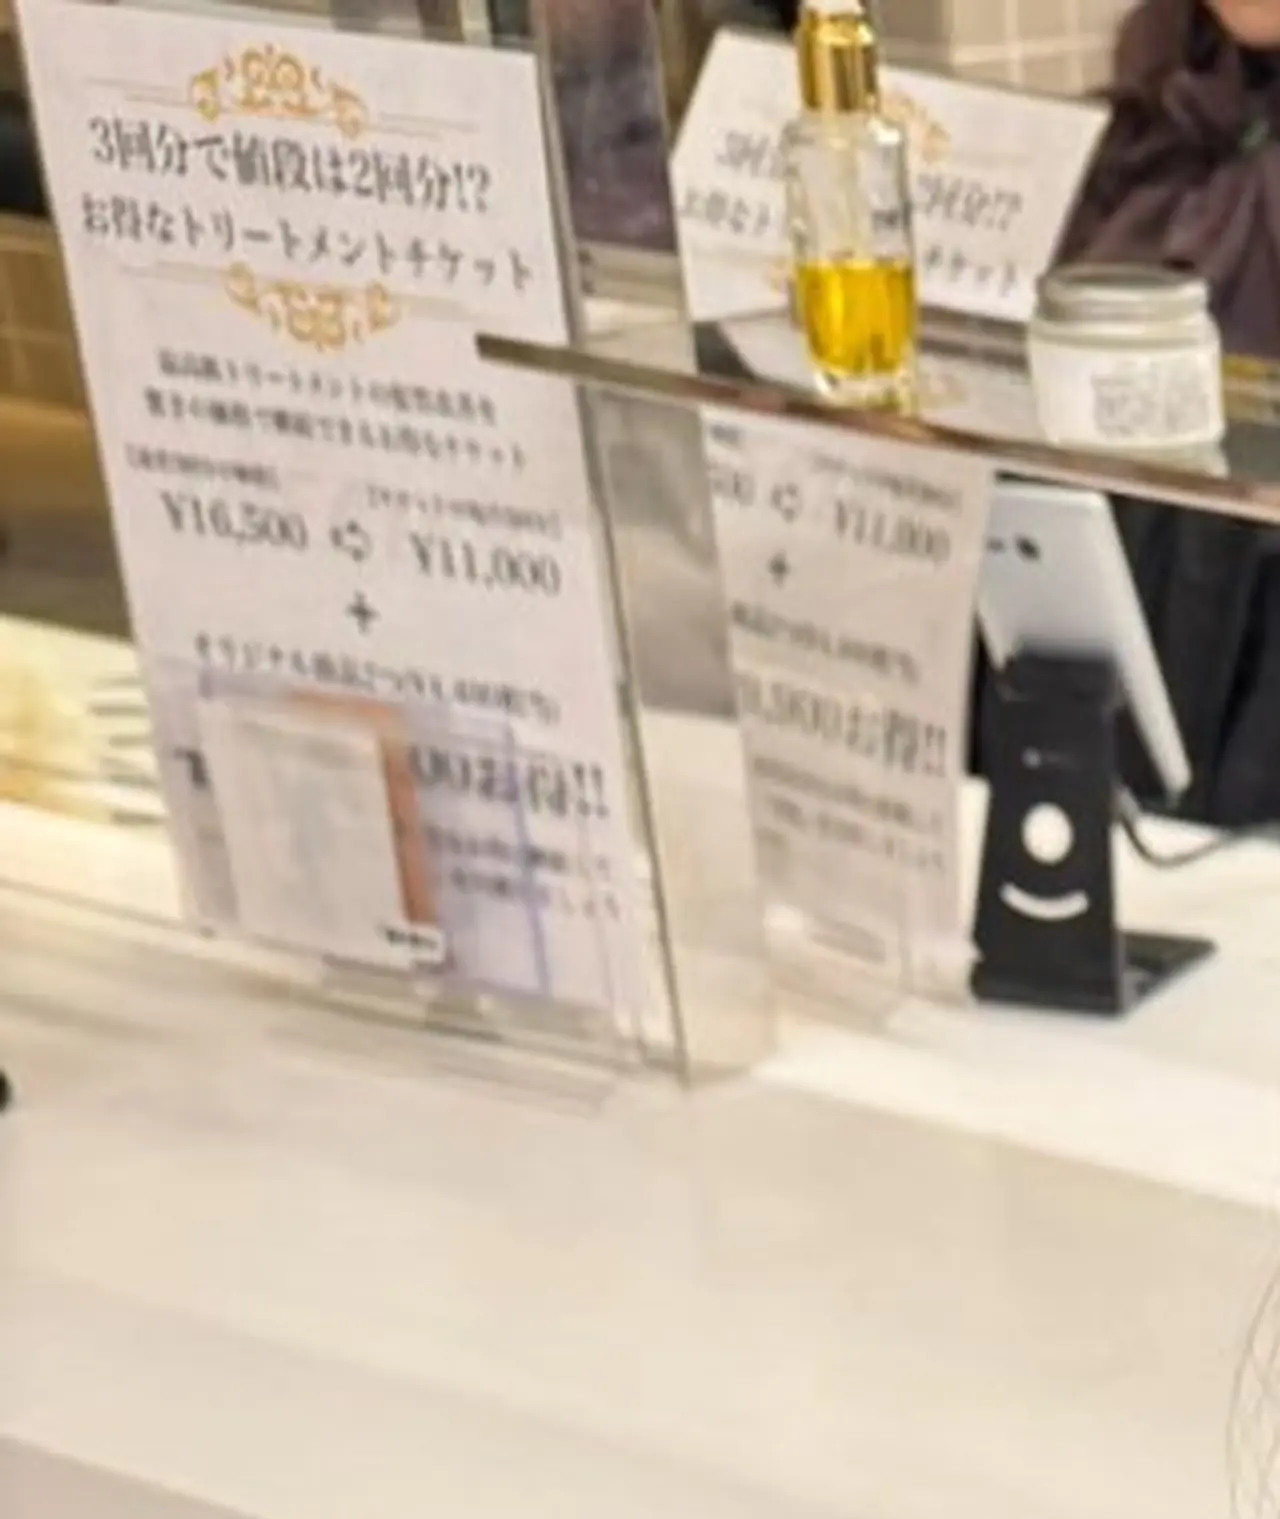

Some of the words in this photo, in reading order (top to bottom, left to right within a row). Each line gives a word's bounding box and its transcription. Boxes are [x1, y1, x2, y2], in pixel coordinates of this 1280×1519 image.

[88, 114, 493, 216] 3回分で値段は2回分!?
[80, 192, 534, 292] お得なトリートメントチケット
[159, 490, 309, 553] ¥16,500
[410, 530, 563, 598] ¥11,000
